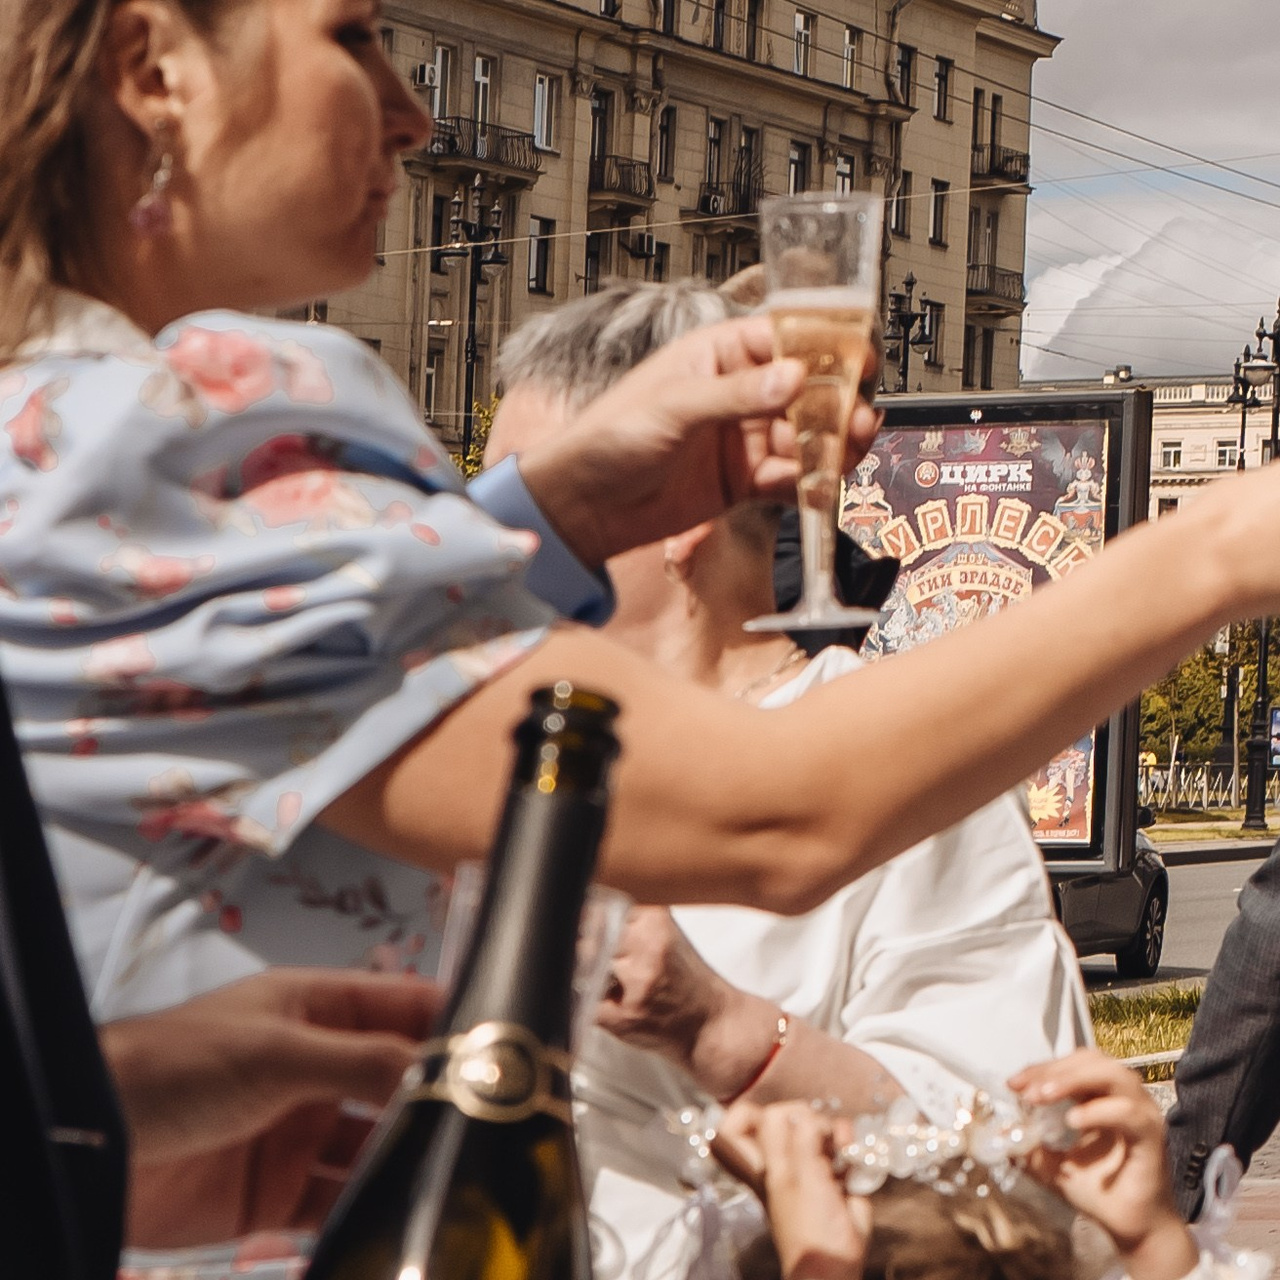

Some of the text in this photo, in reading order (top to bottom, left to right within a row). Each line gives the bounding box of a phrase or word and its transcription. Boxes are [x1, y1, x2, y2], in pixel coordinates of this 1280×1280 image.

[940, 463, 1032, 487] ЦИРК
[964, 482, 1032, 493] НА ФОНТАНКЕ
[887, 505, 1086, 576] УРЛЕСК
[957, 553, 985, 565] ШОУ
[917, 571, 1024, 596] ГИИ ЭРАДЗЕ
